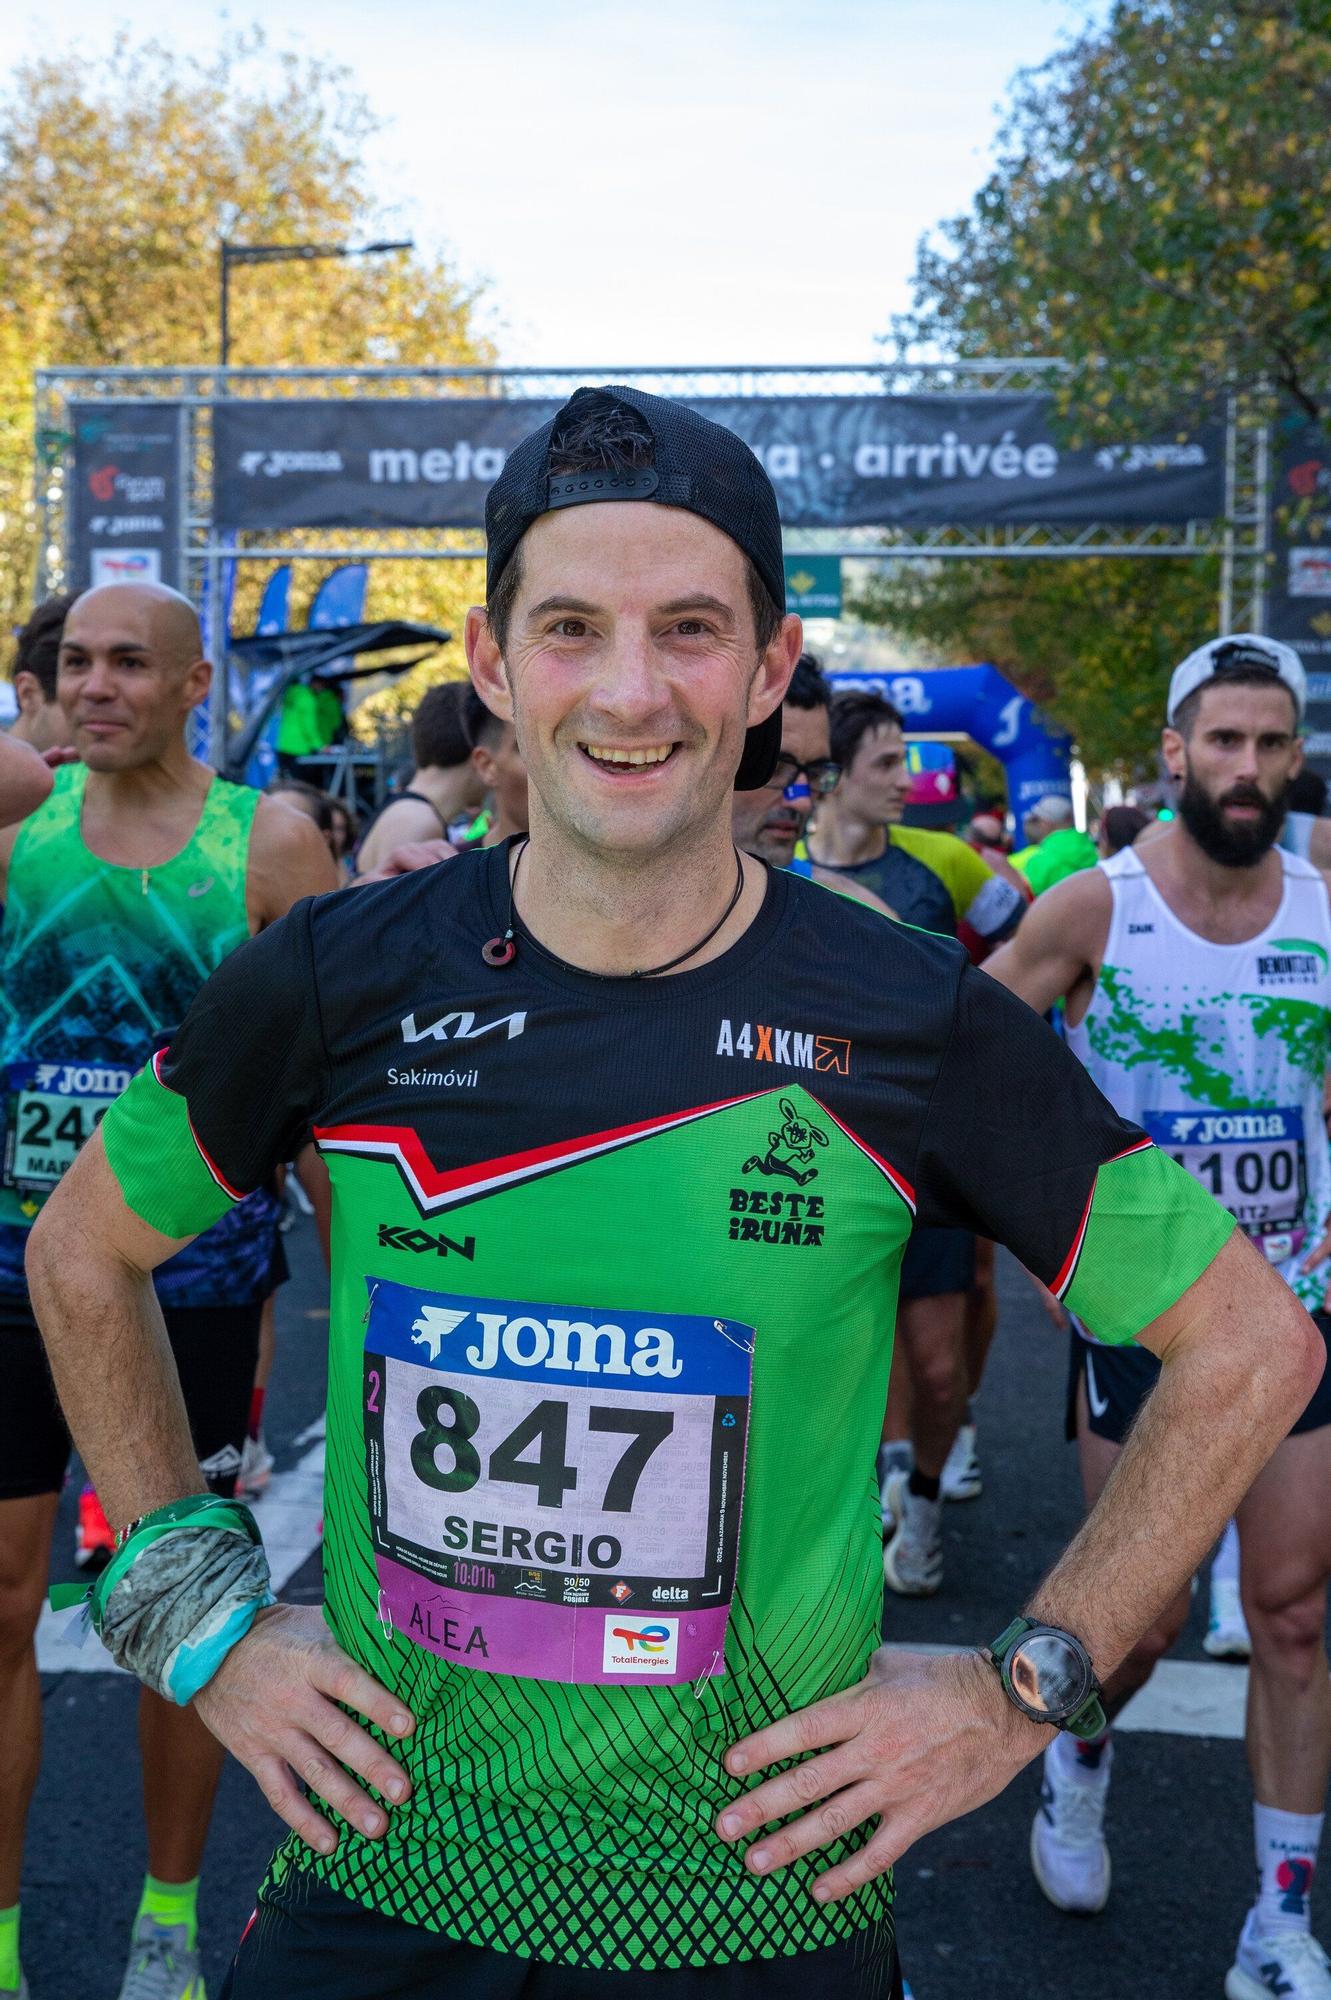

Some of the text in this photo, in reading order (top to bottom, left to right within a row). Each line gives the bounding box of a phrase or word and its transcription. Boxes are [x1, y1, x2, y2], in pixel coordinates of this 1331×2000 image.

[368, 441, 506, 482] meta
[853, 430, 1058, 479] arrivée
[716, 1019, 814, 1070] A4XKM
[58, 1065, 131, 1094] Jom
[388, 1068, 478, 1088] Sakimóvil
[20, 1101, 108, 1151] 24
[729, 1189, 824, 1219] BESTE
[410, 1385, 674, 1513] 847
[721, 1450, 729, 1479] NOVEMBER
[442, 1516, 623, 1569] SERGIO
[453, 1561, 496, 1589] 10:01h
[563, 1575, 590, 1588] 50/50
[652, 1586, 689, 1600] delta
[410, 1603, 489, 1659] ALEA
[611, 1655, 669, 1667] TotalEnergies
